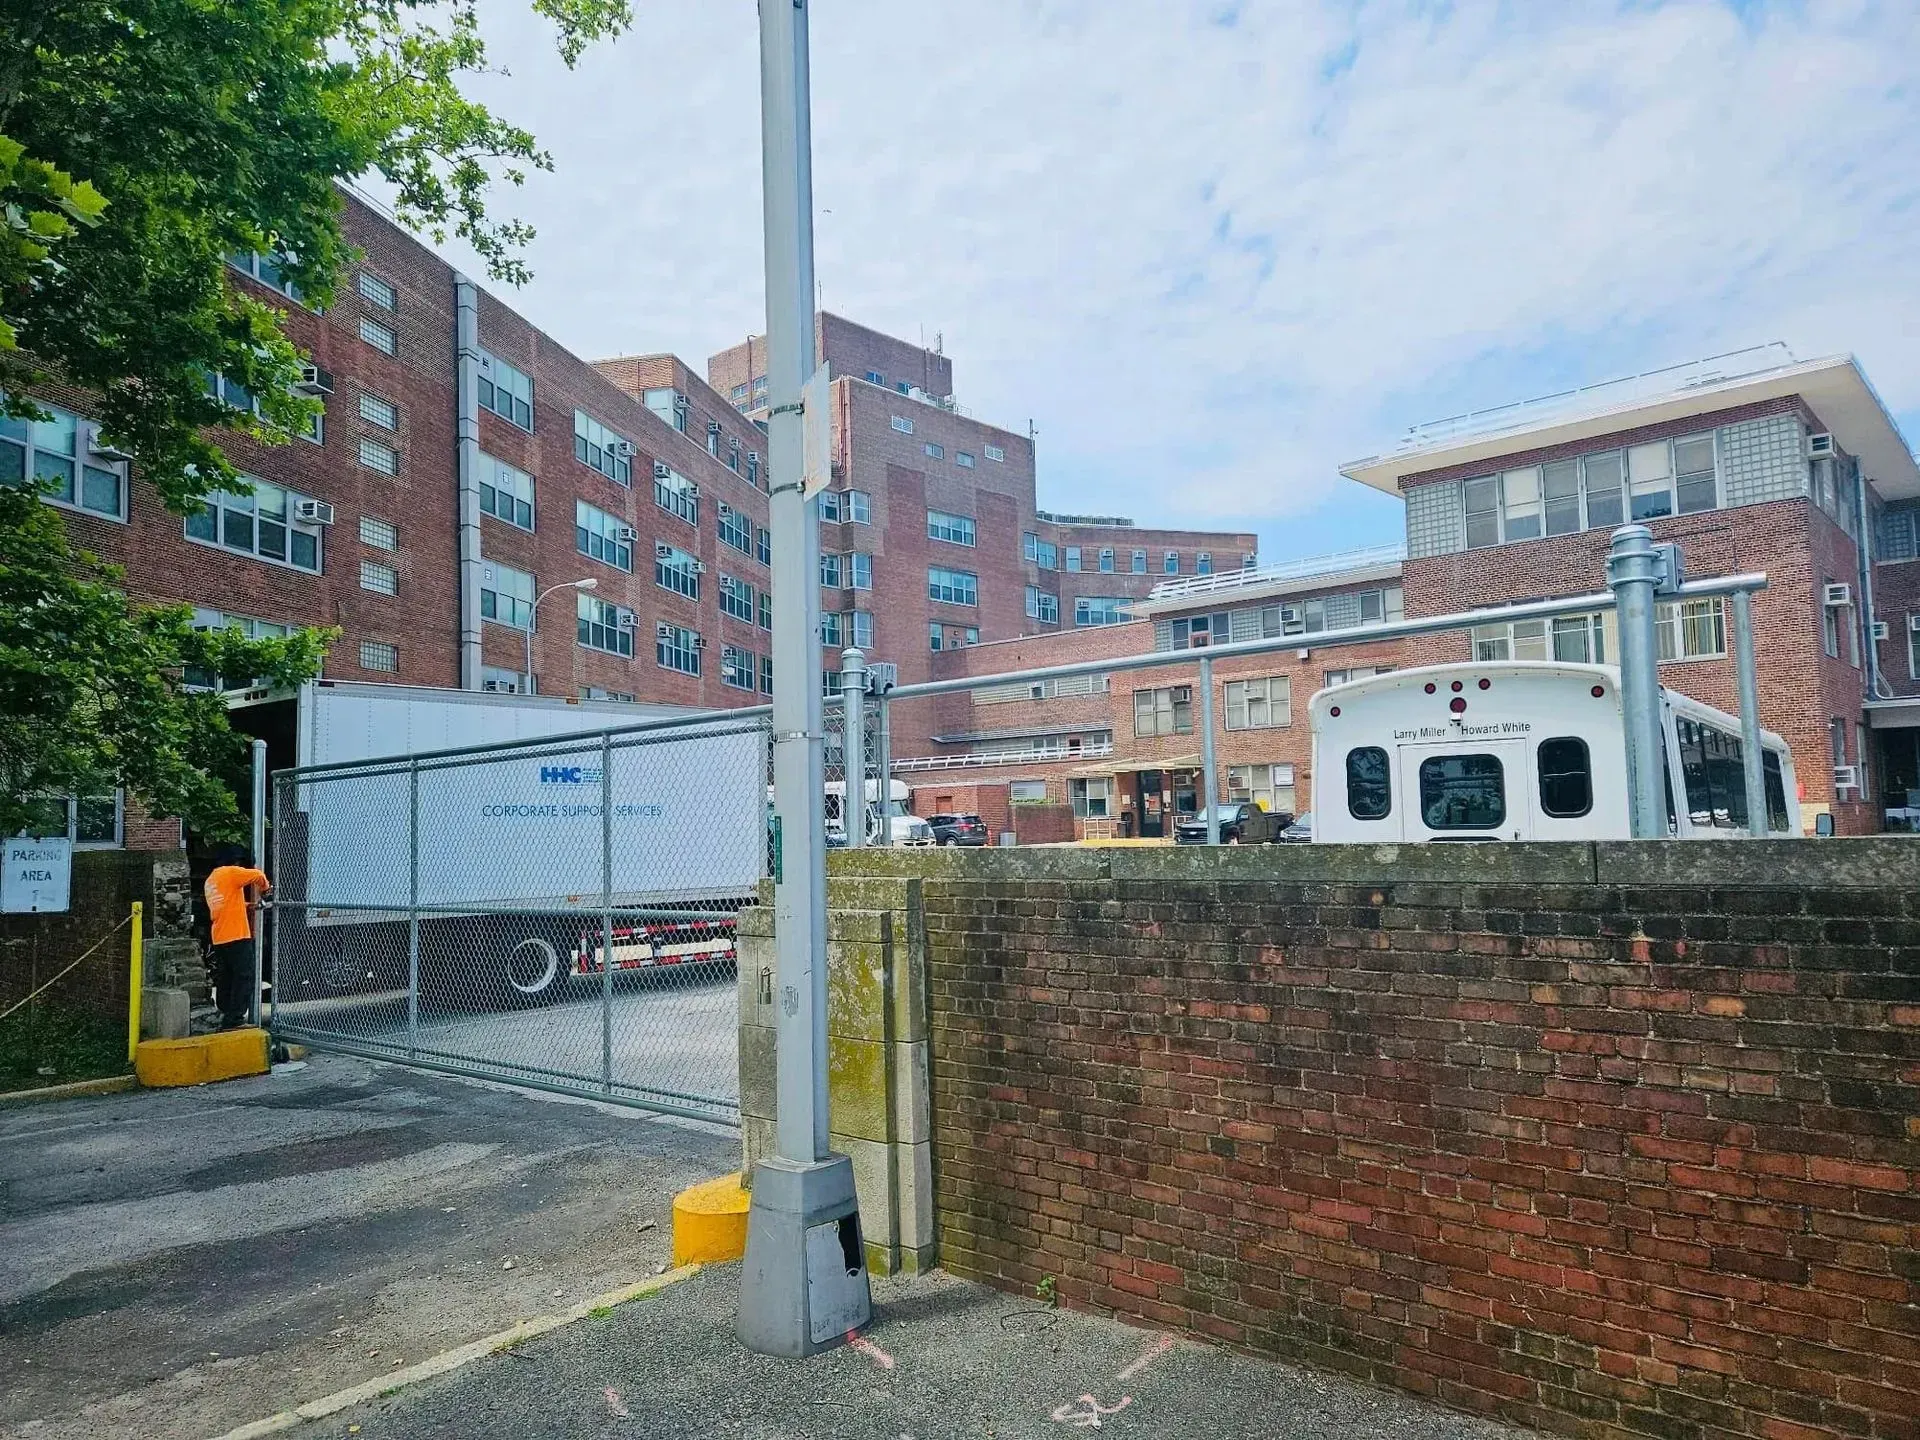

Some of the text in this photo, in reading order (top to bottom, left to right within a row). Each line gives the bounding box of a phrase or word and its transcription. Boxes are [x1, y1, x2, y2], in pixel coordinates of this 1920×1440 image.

[1394, 722, 1531, 740] Larry Miller Howard White
[541, 767, 581, 783] HHC
[482, 804, 558, 817] CORPORATE
[616, 804, 662, 817] SERVICES
[20, 870, 52, 881] AREA
